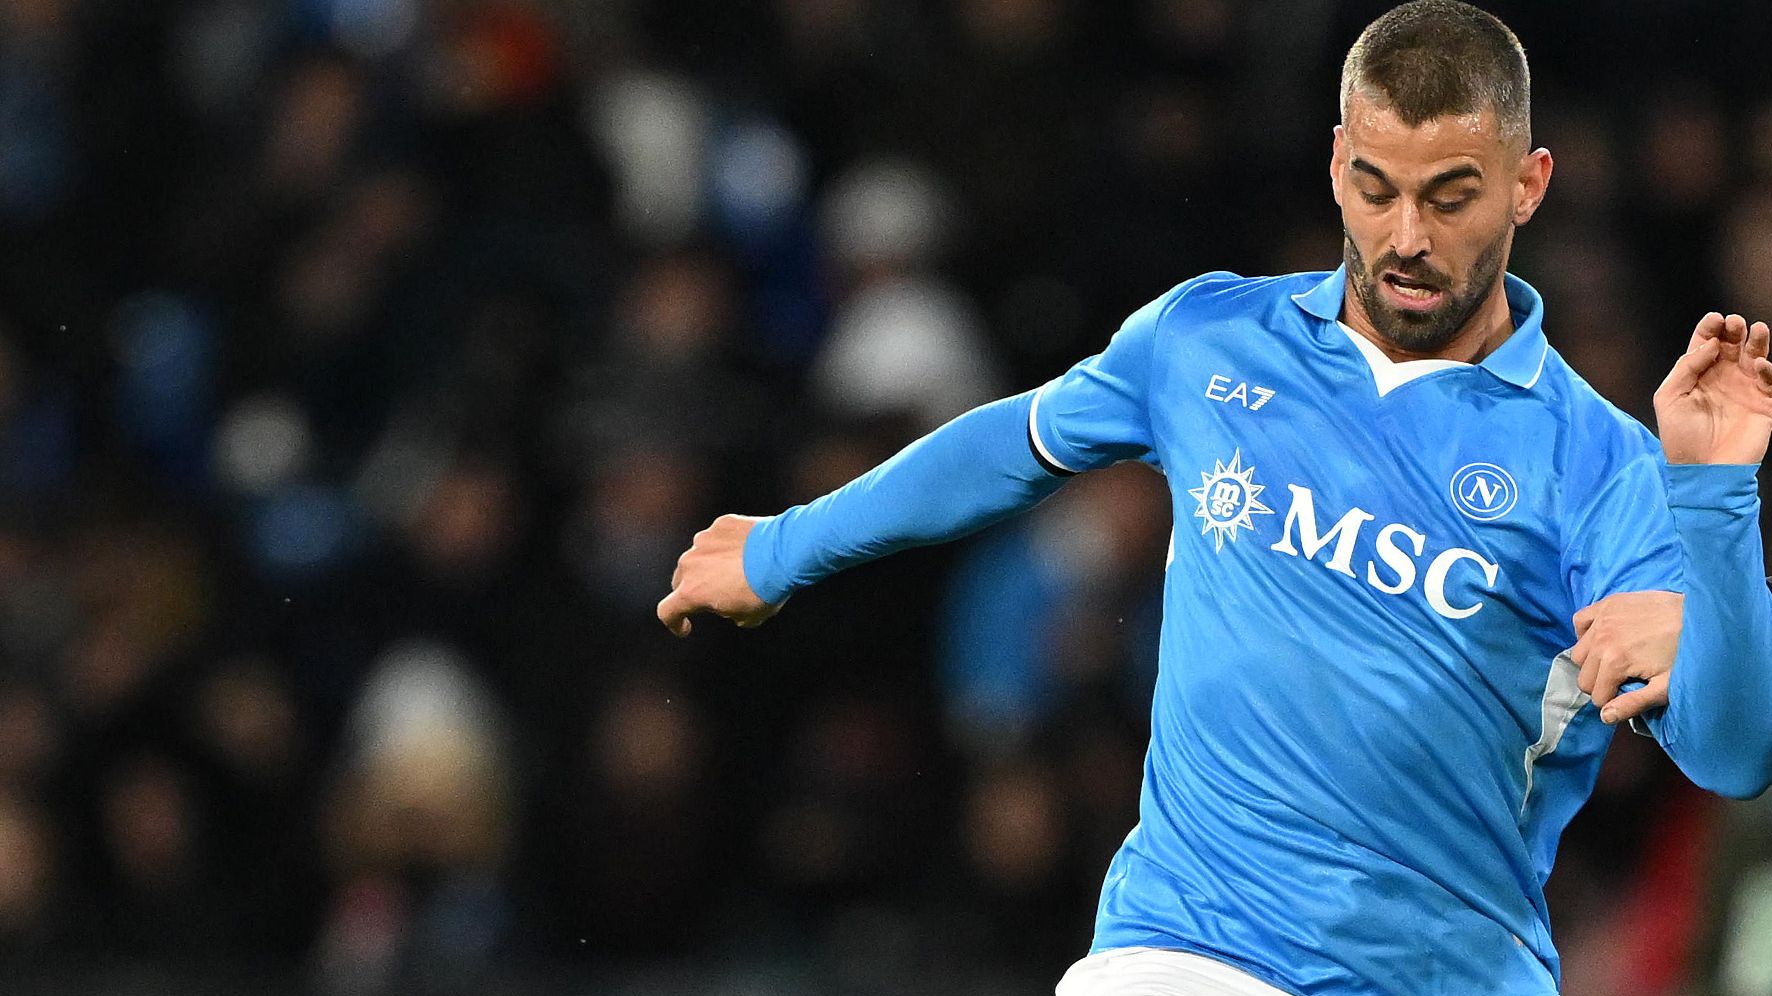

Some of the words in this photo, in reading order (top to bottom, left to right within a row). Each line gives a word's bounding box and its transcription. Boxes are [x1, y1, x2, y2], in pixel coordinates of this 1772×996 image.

[1204, 373, 1276, 411] EA7
[1465, 475, 1502, 508] N
[1270, 483, 1498, 619] MSC
